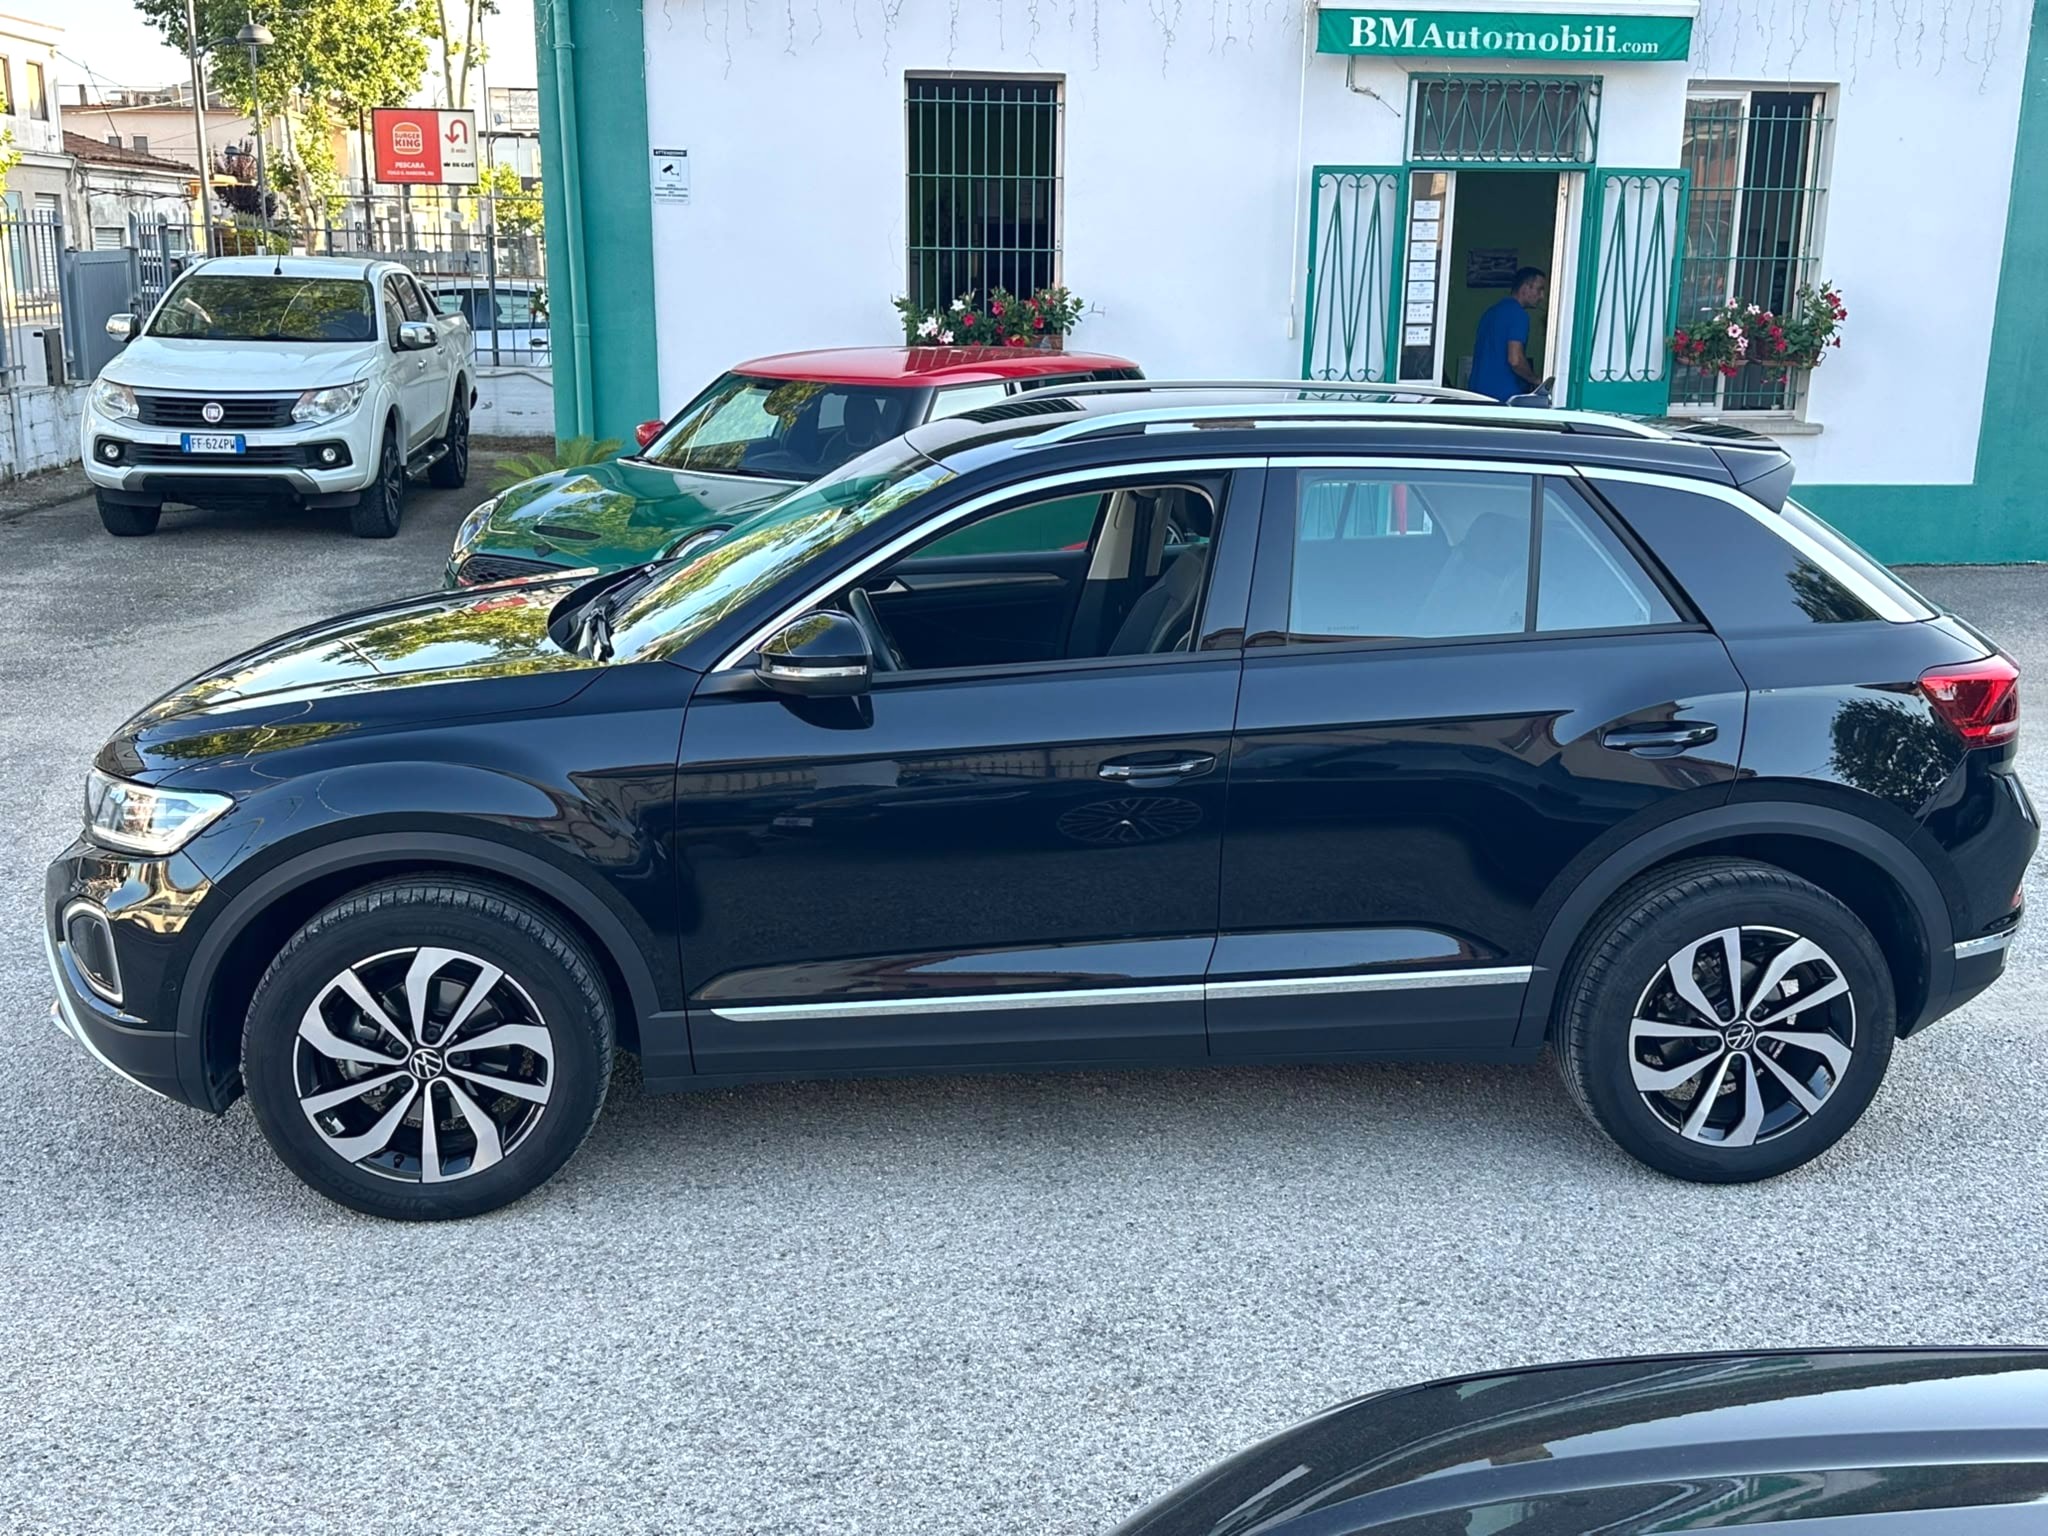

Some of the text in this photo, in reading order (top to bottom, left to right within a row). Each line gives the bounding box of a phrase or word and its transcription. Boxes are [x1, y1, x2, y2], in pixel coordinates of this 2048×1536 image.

[1349, 16, 1658, 53] BMAutomobili.com
[394, 139, 421, 148] KING
[192, 438, 203, 449] FF
[205, 438, 236, 450] 624PW
